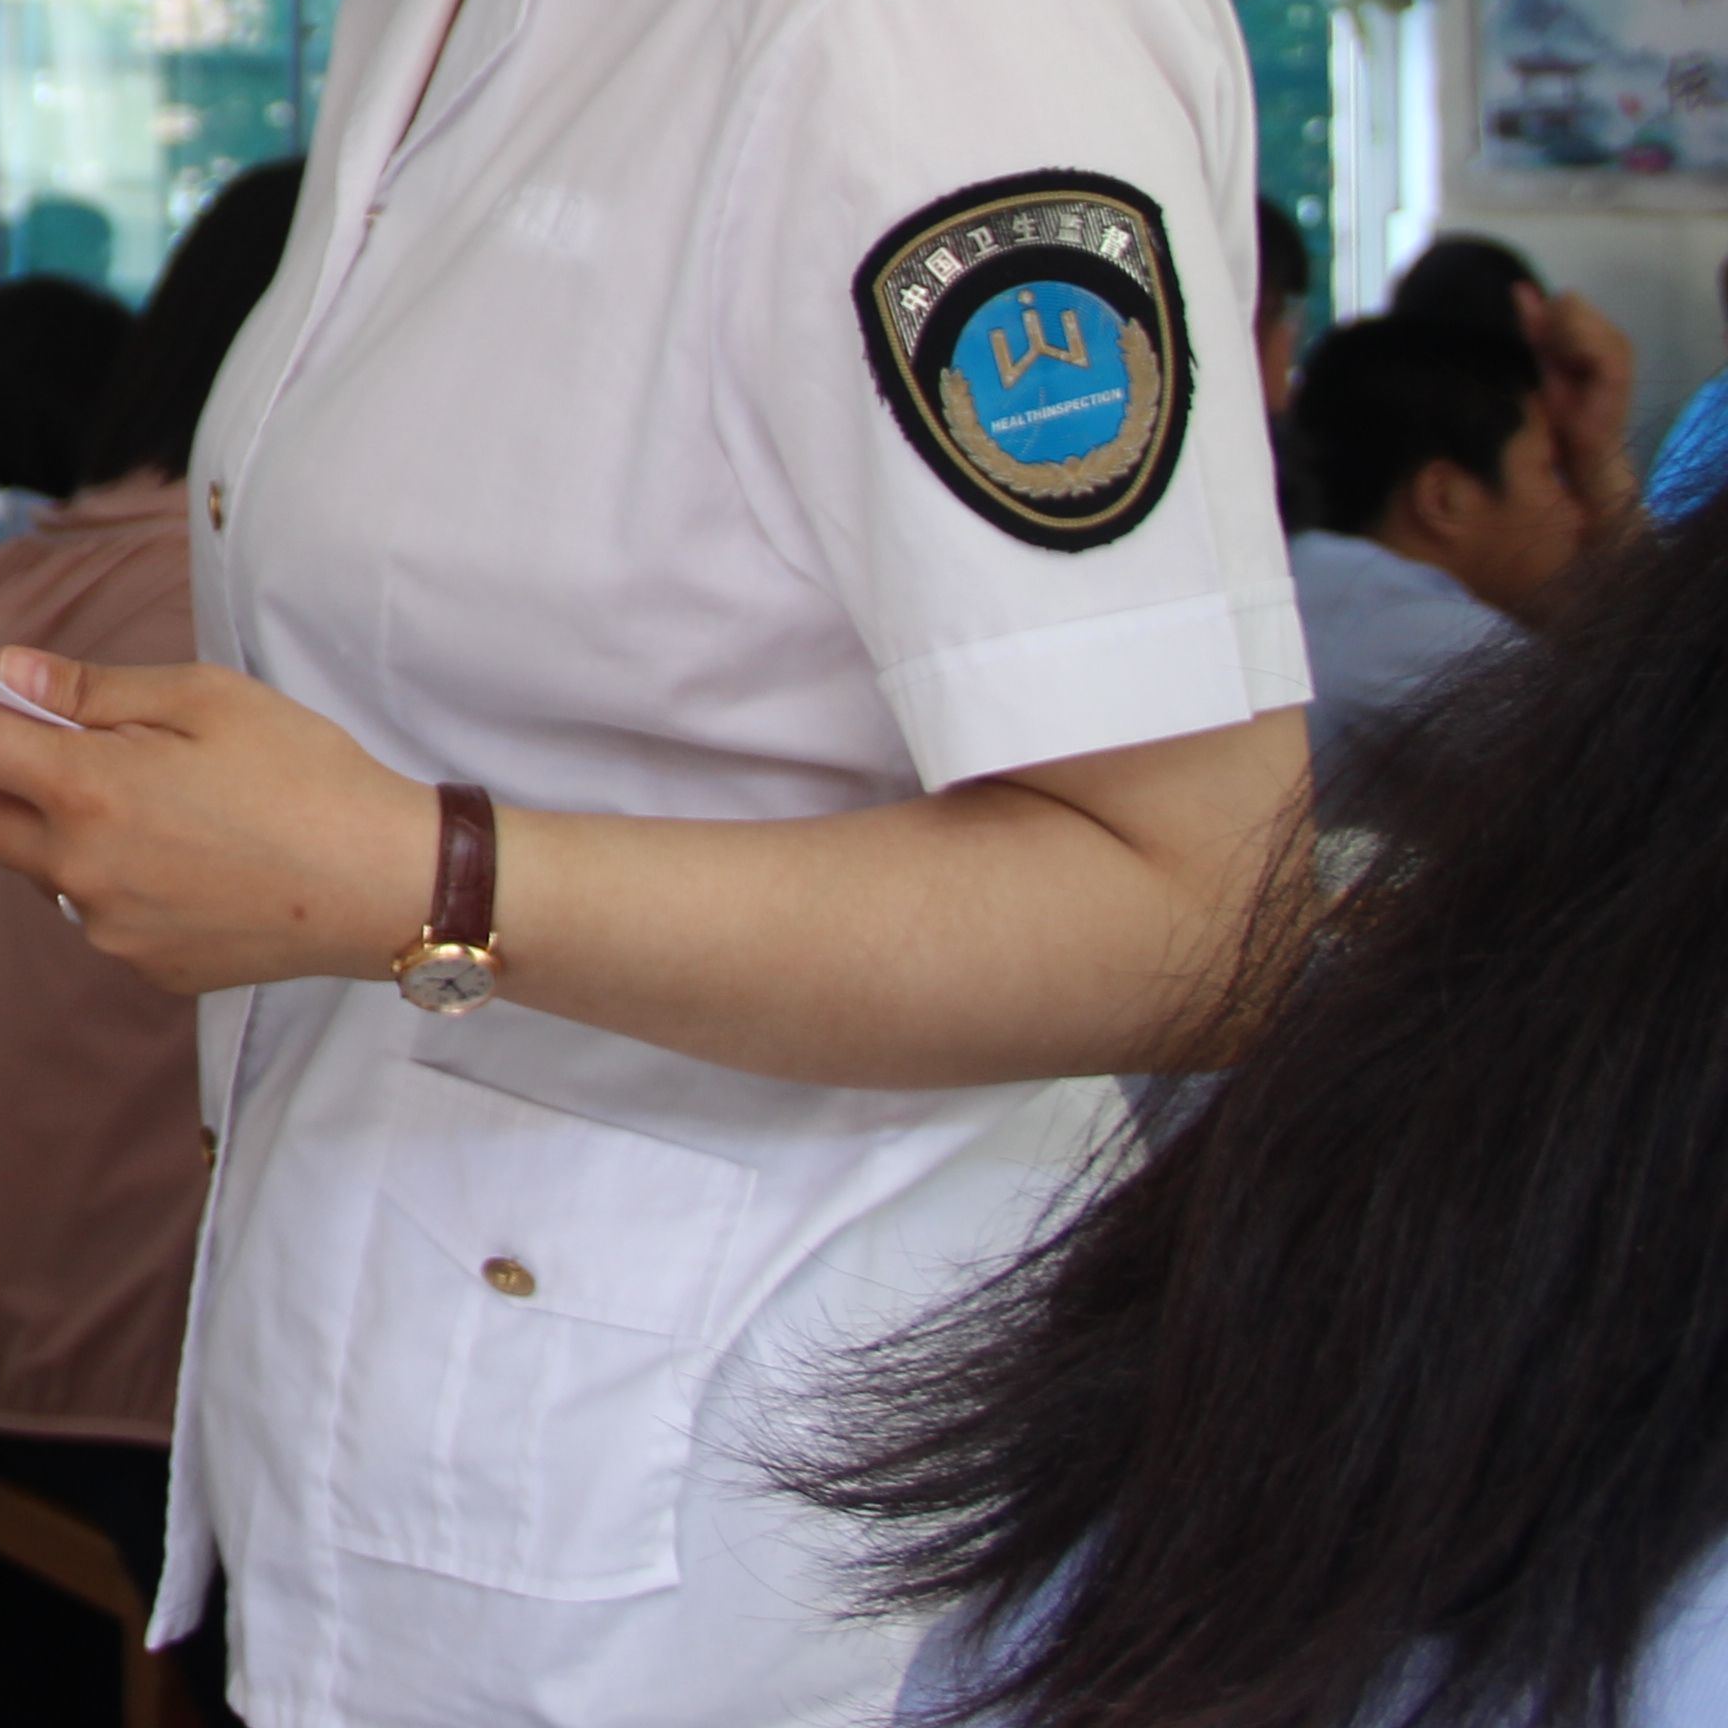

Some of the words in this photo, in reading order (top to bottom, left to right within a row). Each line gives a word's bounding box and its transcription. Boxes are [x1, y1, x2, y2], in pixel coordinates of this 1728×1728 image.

[899, 211, 1132, 313] 中国卫生监督
